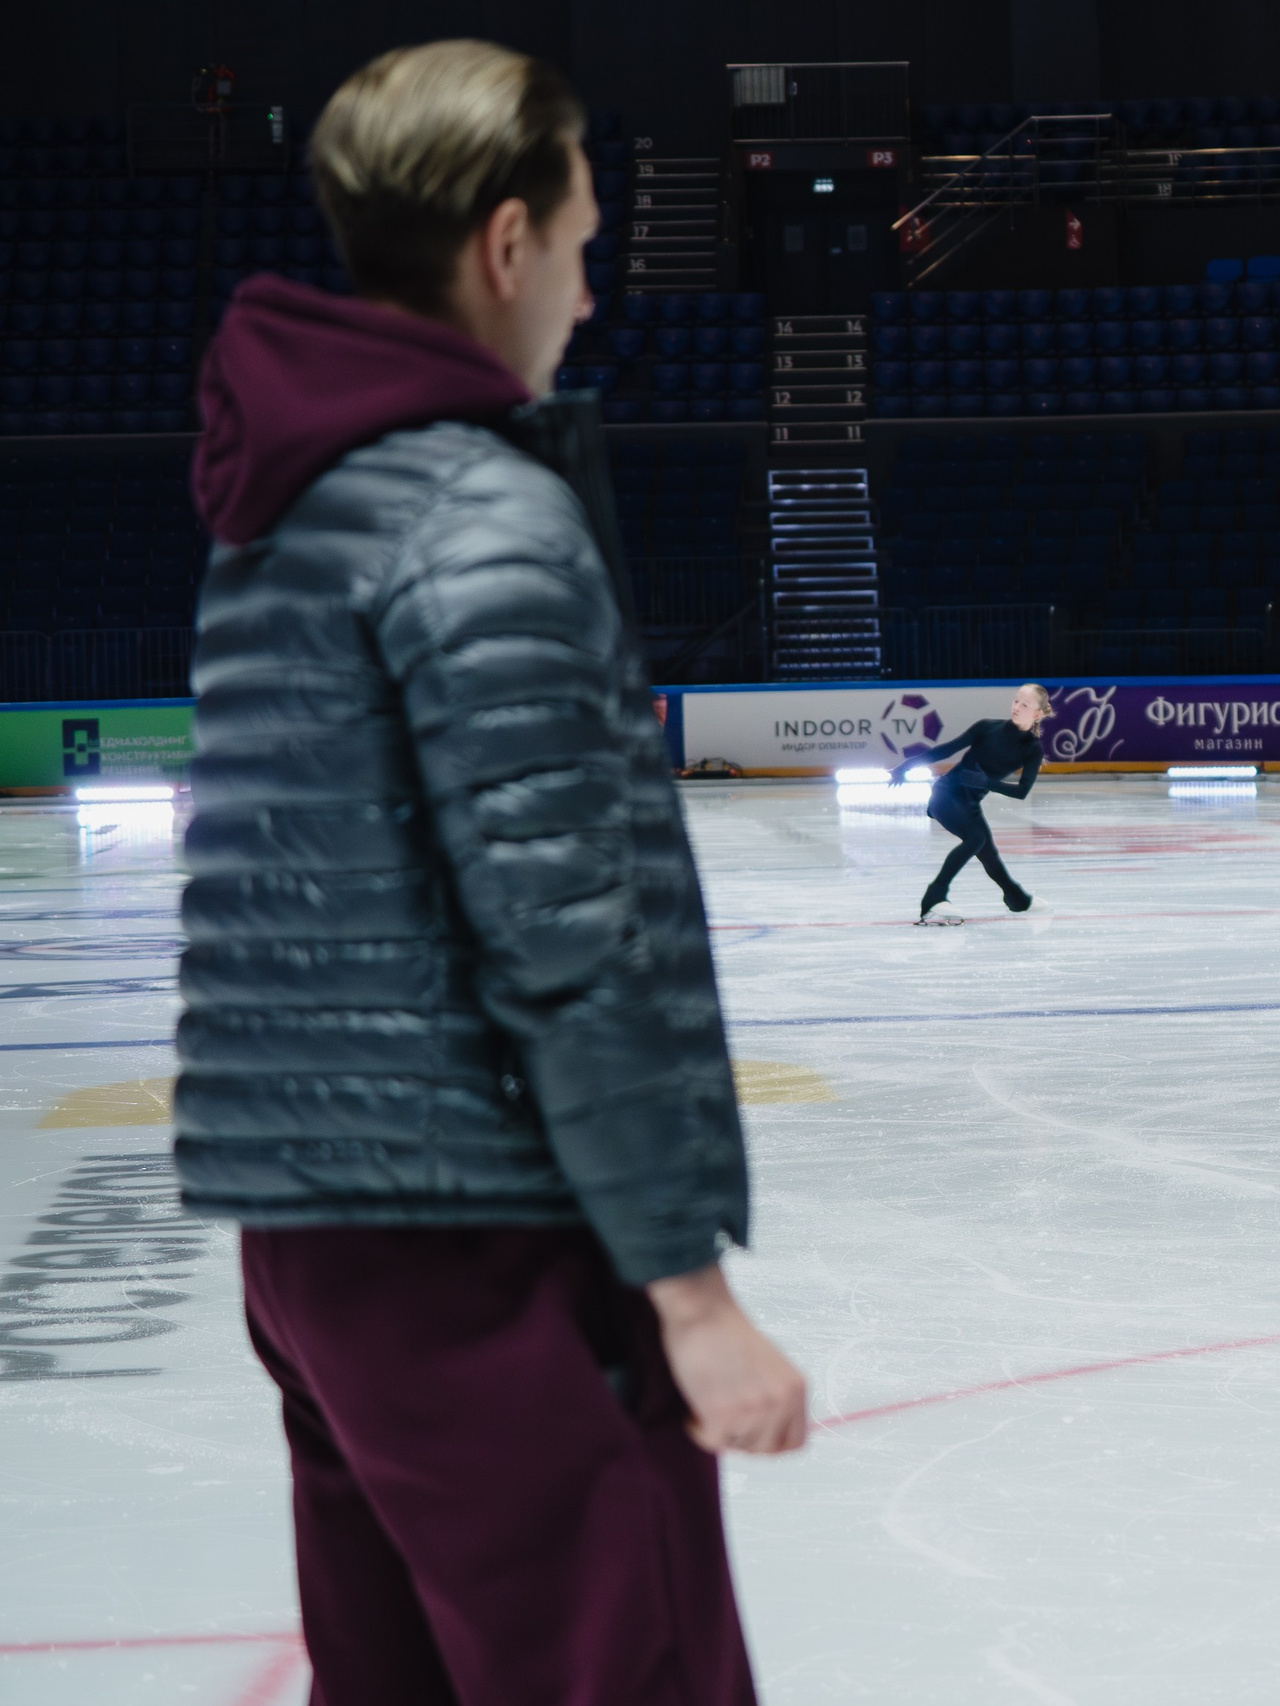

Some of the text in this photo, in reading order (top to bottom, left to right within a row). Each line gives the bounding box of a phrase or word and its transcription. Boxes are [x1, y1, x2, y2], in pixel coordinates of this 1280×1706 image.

[750, 153, 771, 167] P2
[872, 152, 894, 166] P3
[633, 226, 649, 238] 17
[775, 391, 791, 404] 12
[846, 390, 862, 403] 12
[775, 427, 789, 440] 11
[847, 425, 860, 439] 11
[774, 719, 917, 737] INDOOR TV
[1194, 738, 1264, 750] магазин
